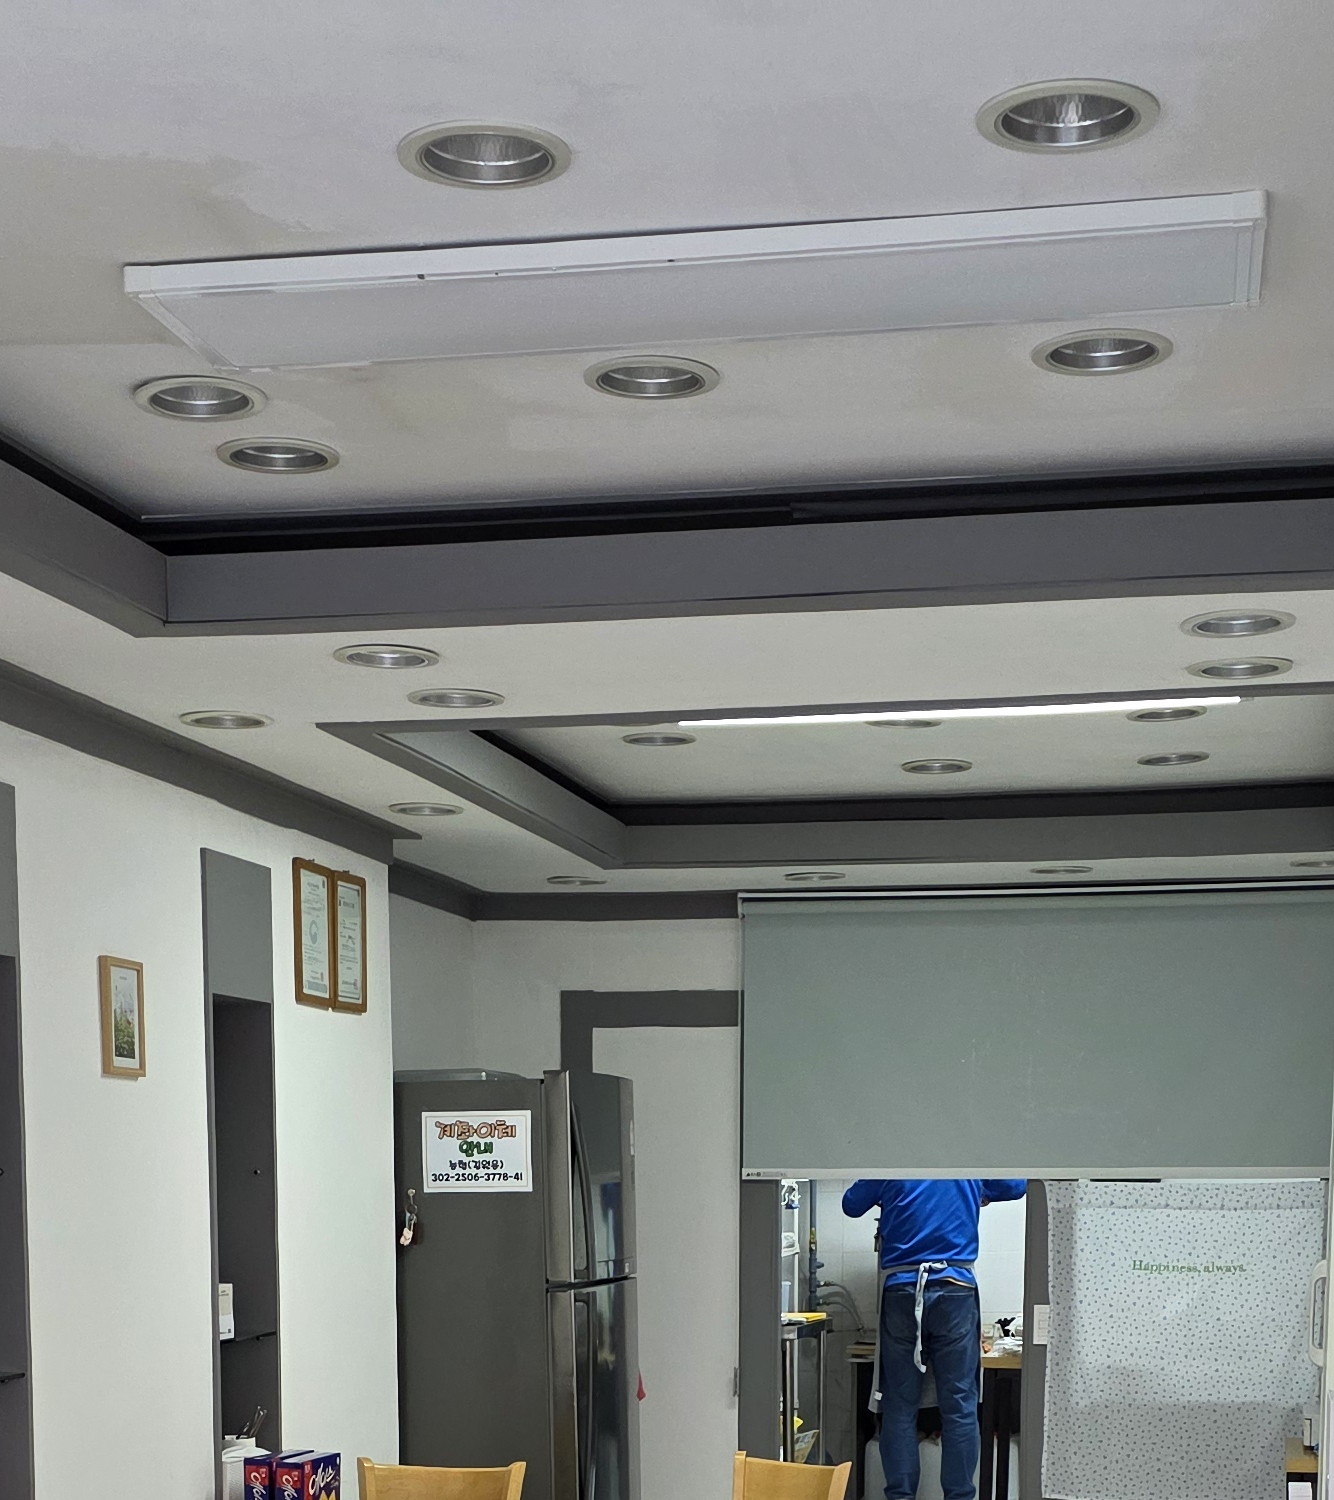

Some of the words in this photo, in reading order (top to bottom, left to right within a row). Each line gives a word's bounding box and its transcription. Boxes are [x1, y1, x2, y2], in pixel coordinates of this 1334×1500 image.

[435, 1120, 516, 1140] 계좌이체
[459, 1140, 493, 1157] 안내
[431, 1172, 523, 1182] 302-2506-3778-41
